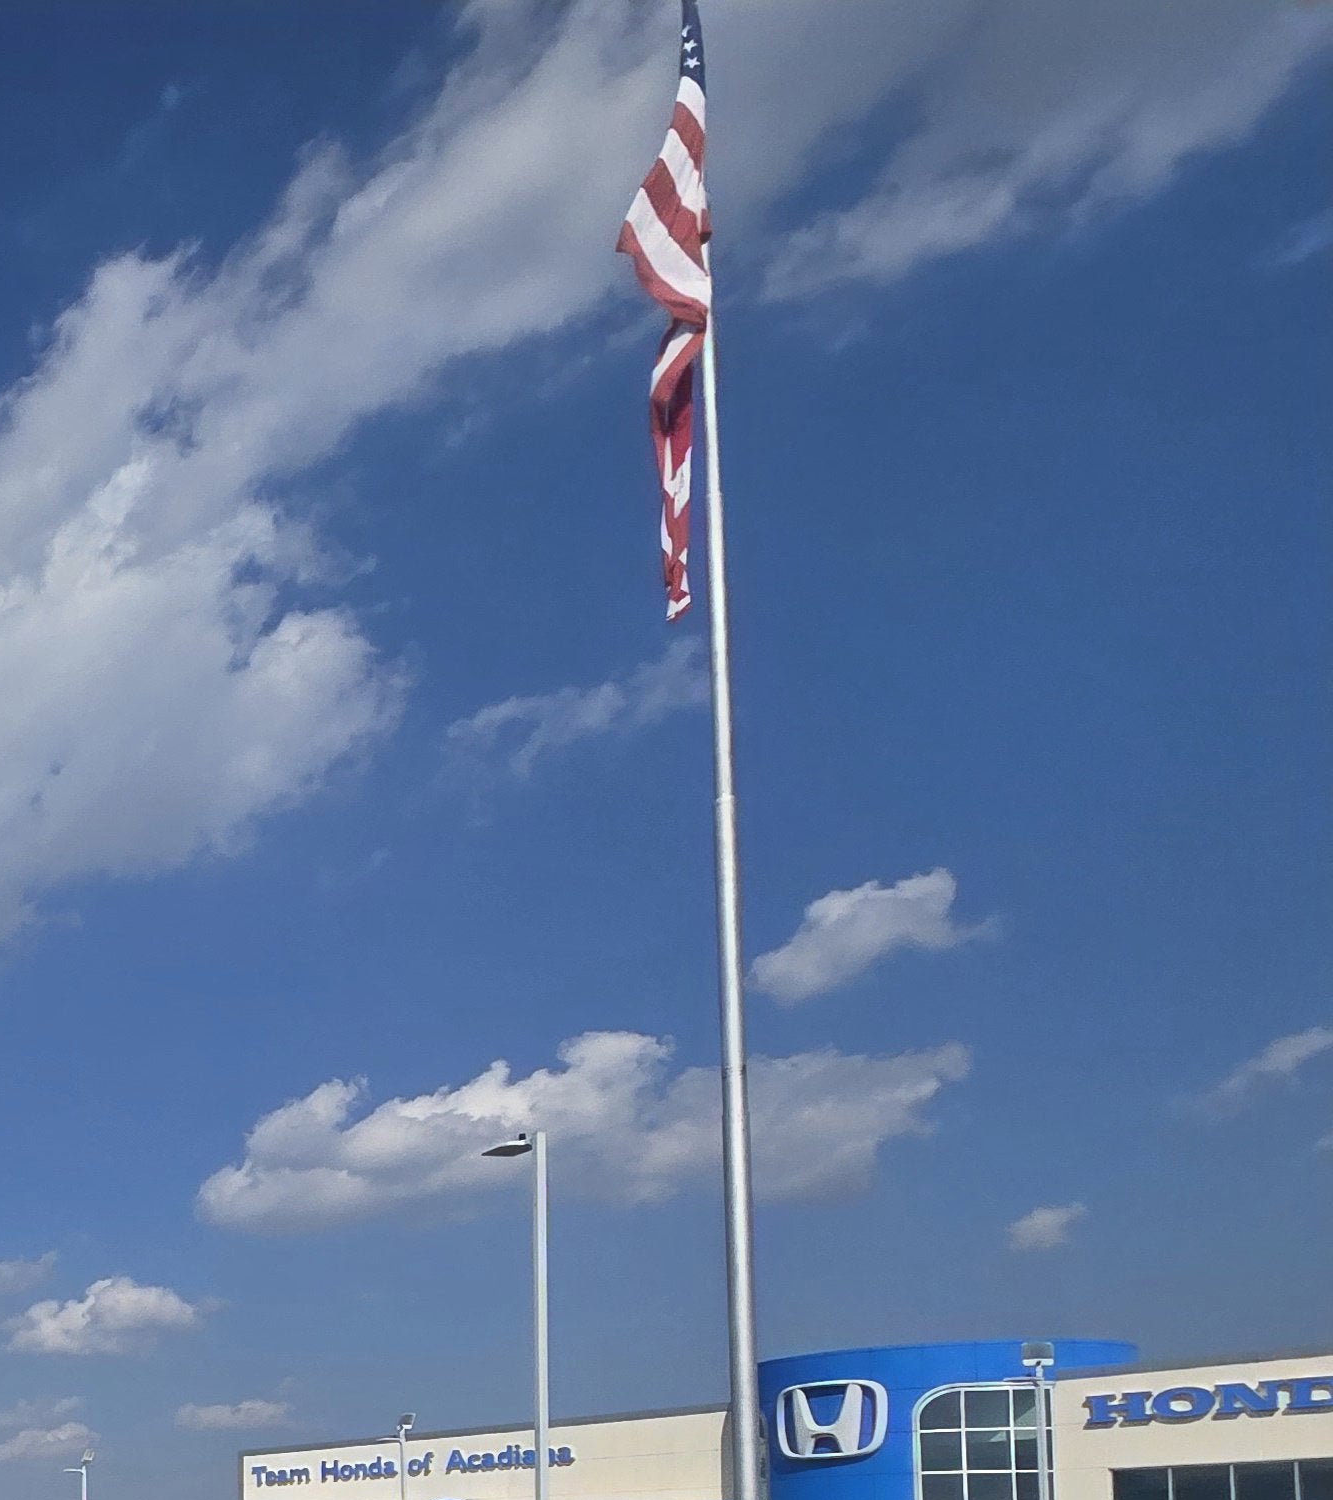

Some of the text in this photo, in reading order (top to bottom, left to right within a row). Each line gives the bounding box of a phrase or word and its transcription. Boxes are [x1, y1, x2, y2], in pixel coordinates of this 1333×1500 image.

[251, 1465, 311, 1488] Team
[320, 1455, 399, 1483] Honda
[408, 1451, 435, 1477] of
